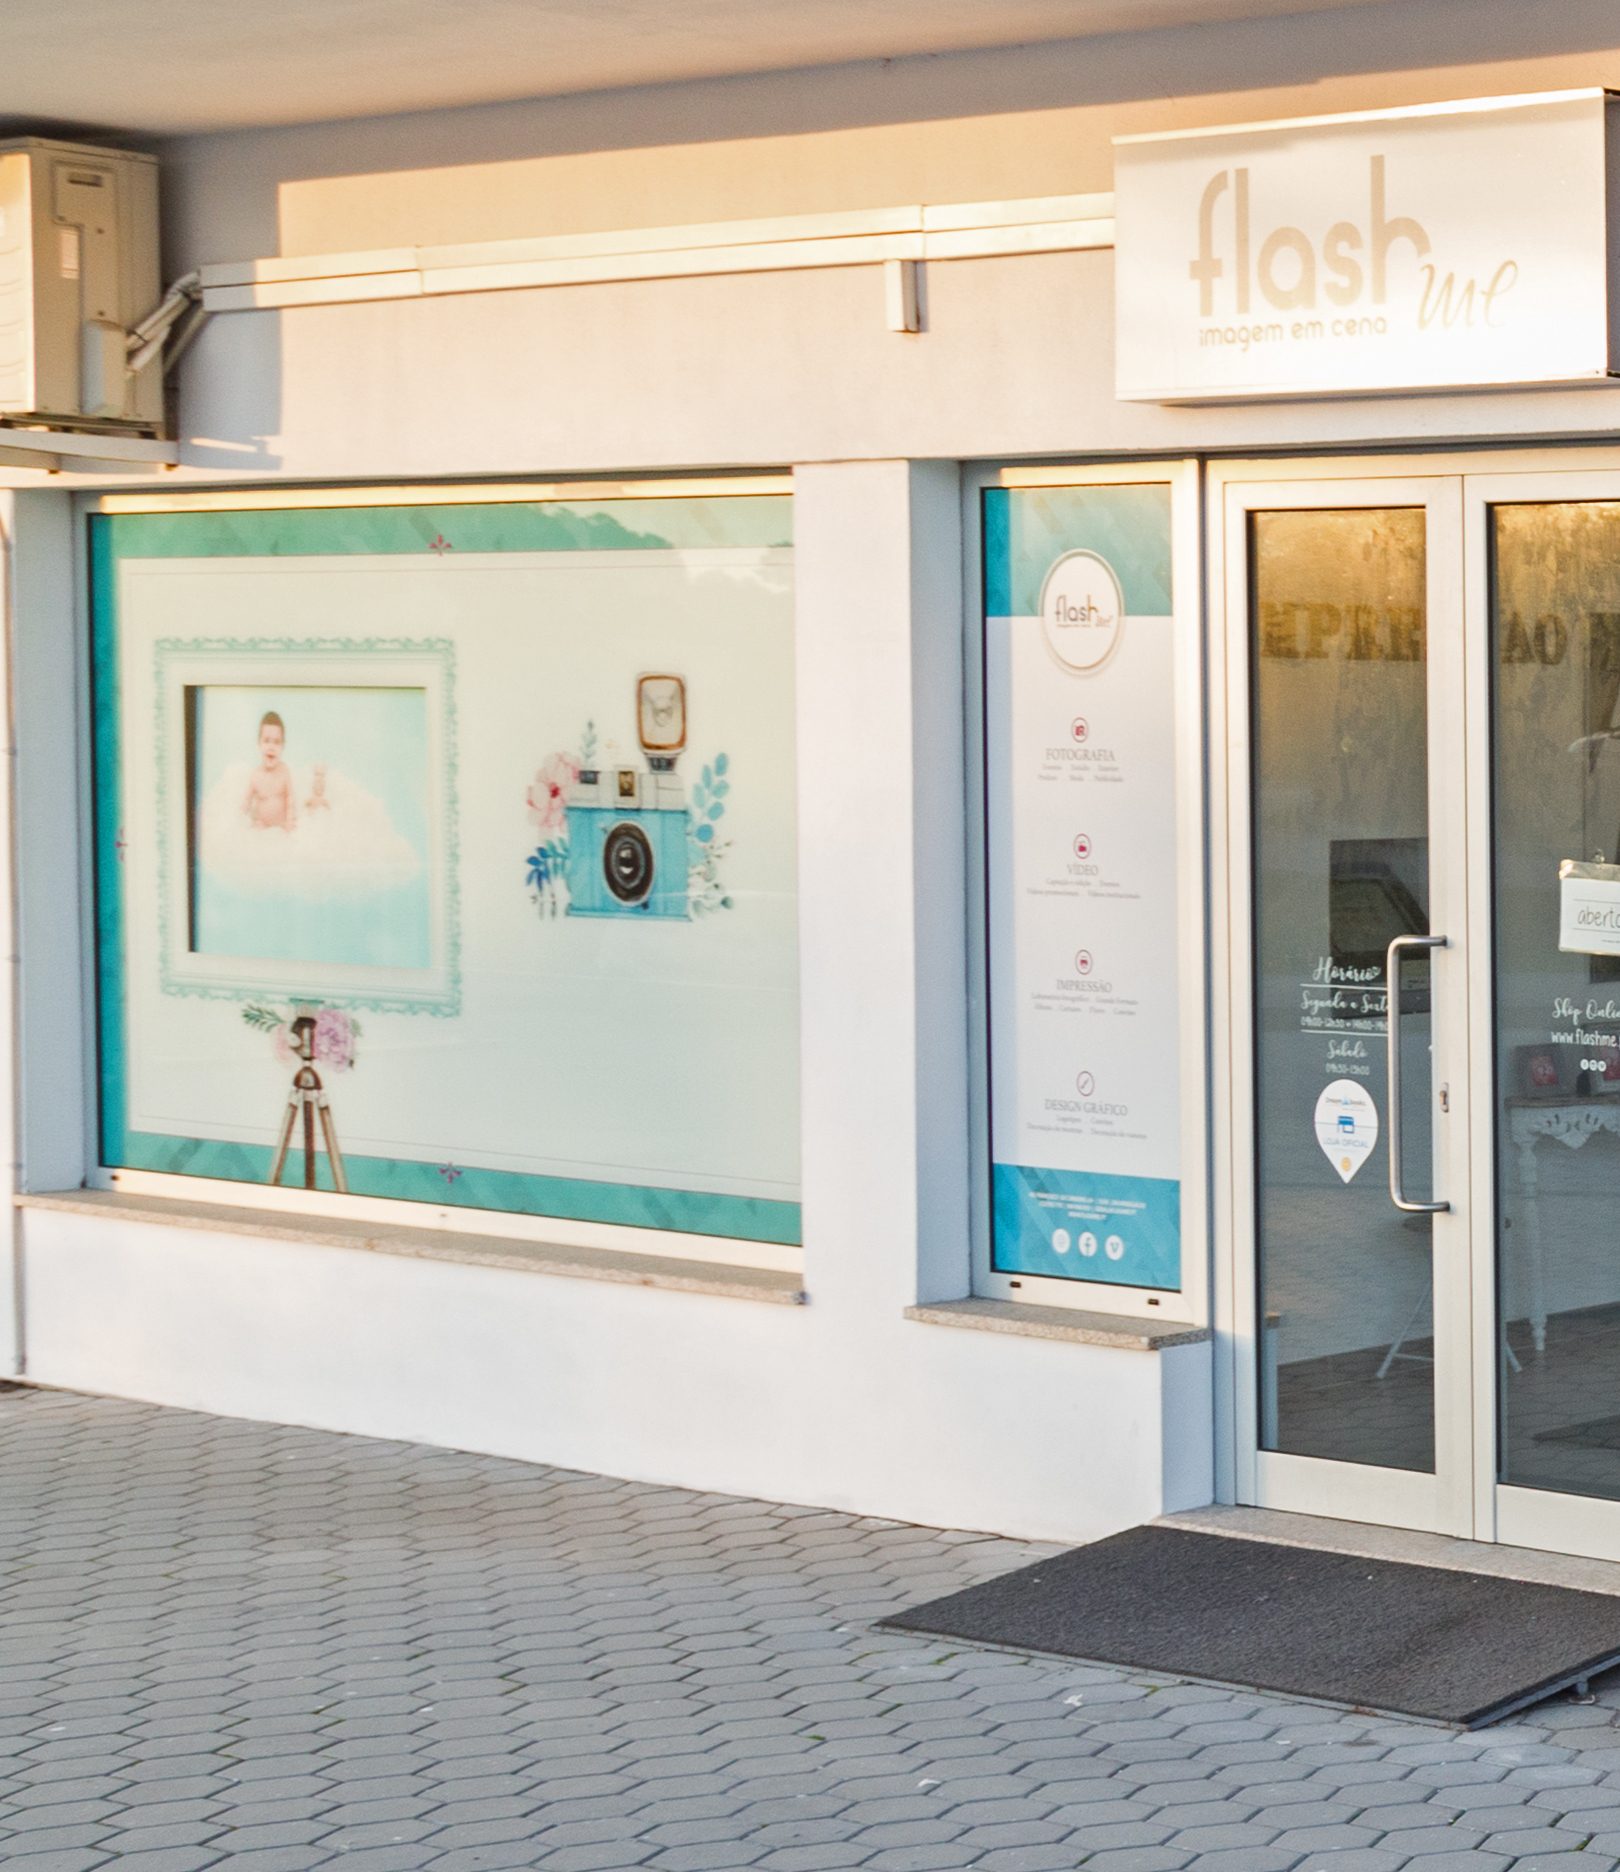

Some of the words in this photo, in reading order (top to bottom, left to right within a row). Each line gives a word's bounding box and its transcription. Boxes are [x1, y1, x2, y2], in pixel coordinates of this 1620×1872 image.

[1189, 154, 1432, 317] flash
[1418, 259, 1518, 332] me
[1198, 321, 1284, 352] imagem
[1291, 319, 1325, 340] em
[1332, 315, 1387, 338] cena
[1055, 594, 1099, 622] flash
[1045, 748, 1116, 762] FOTOGRAFIA
[1056, 979, 1112, 993] IMPRESSÃO
[1360, 994, 1388, 1013] Sext
[1552, 998, 1583, 1026] Shop
[1045, 1098, 1081, 1112] DESIGN
